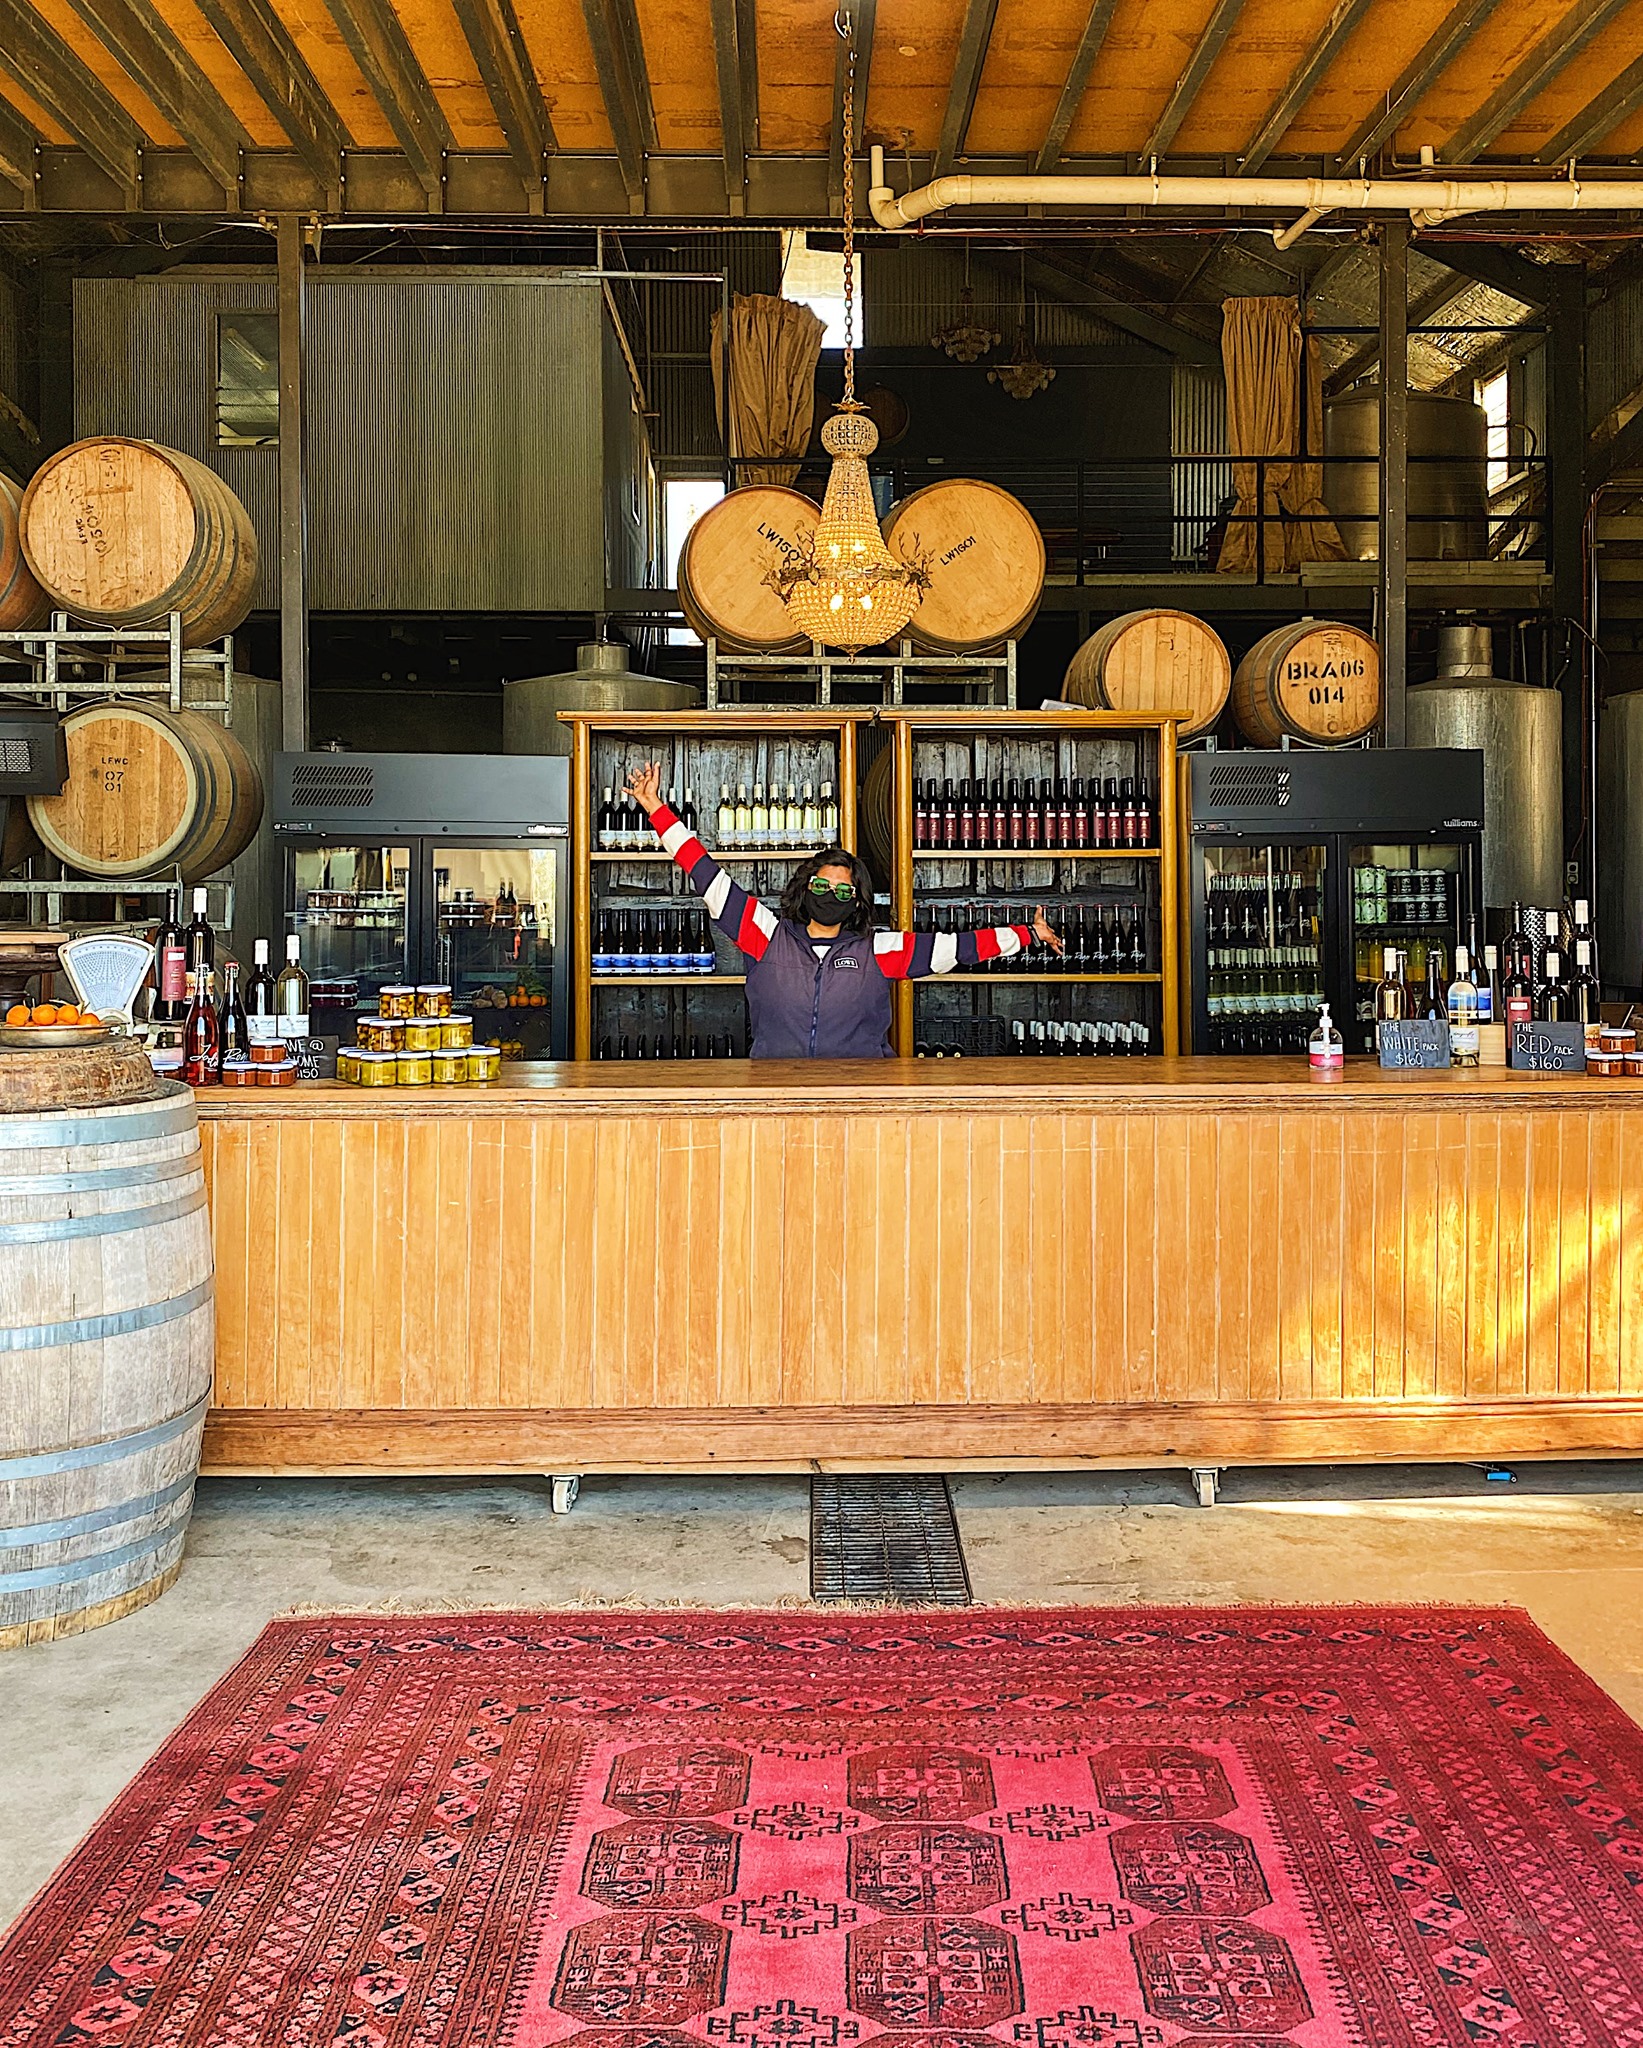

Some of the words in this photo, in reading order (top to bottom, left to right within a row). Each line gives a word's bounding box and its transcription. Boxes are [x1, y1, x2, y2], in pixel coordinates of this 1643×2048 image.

[1287, 660, 1364, 680] BRA06
[1309, 686, 1345, 705] 014
[101, 756, 129, 765] LFWC
[105, 770, 124, 781] 07
[105, 782, 121, 792] 01
[1381, 1022, 1400, 1032] THE
[1514, 1022, 1534, 1032] THE
[1382, 1036, 1420, 1051] WHITE
[1422, 1043, 1439, 1051] PACK
[1516, 1033, 1552, 1054] RED
[1553, 1045, 1575, 1055] PACK
[1395, 1052, 1423, 1066] $160
[1528, 1055, 1563, 1069] $160
